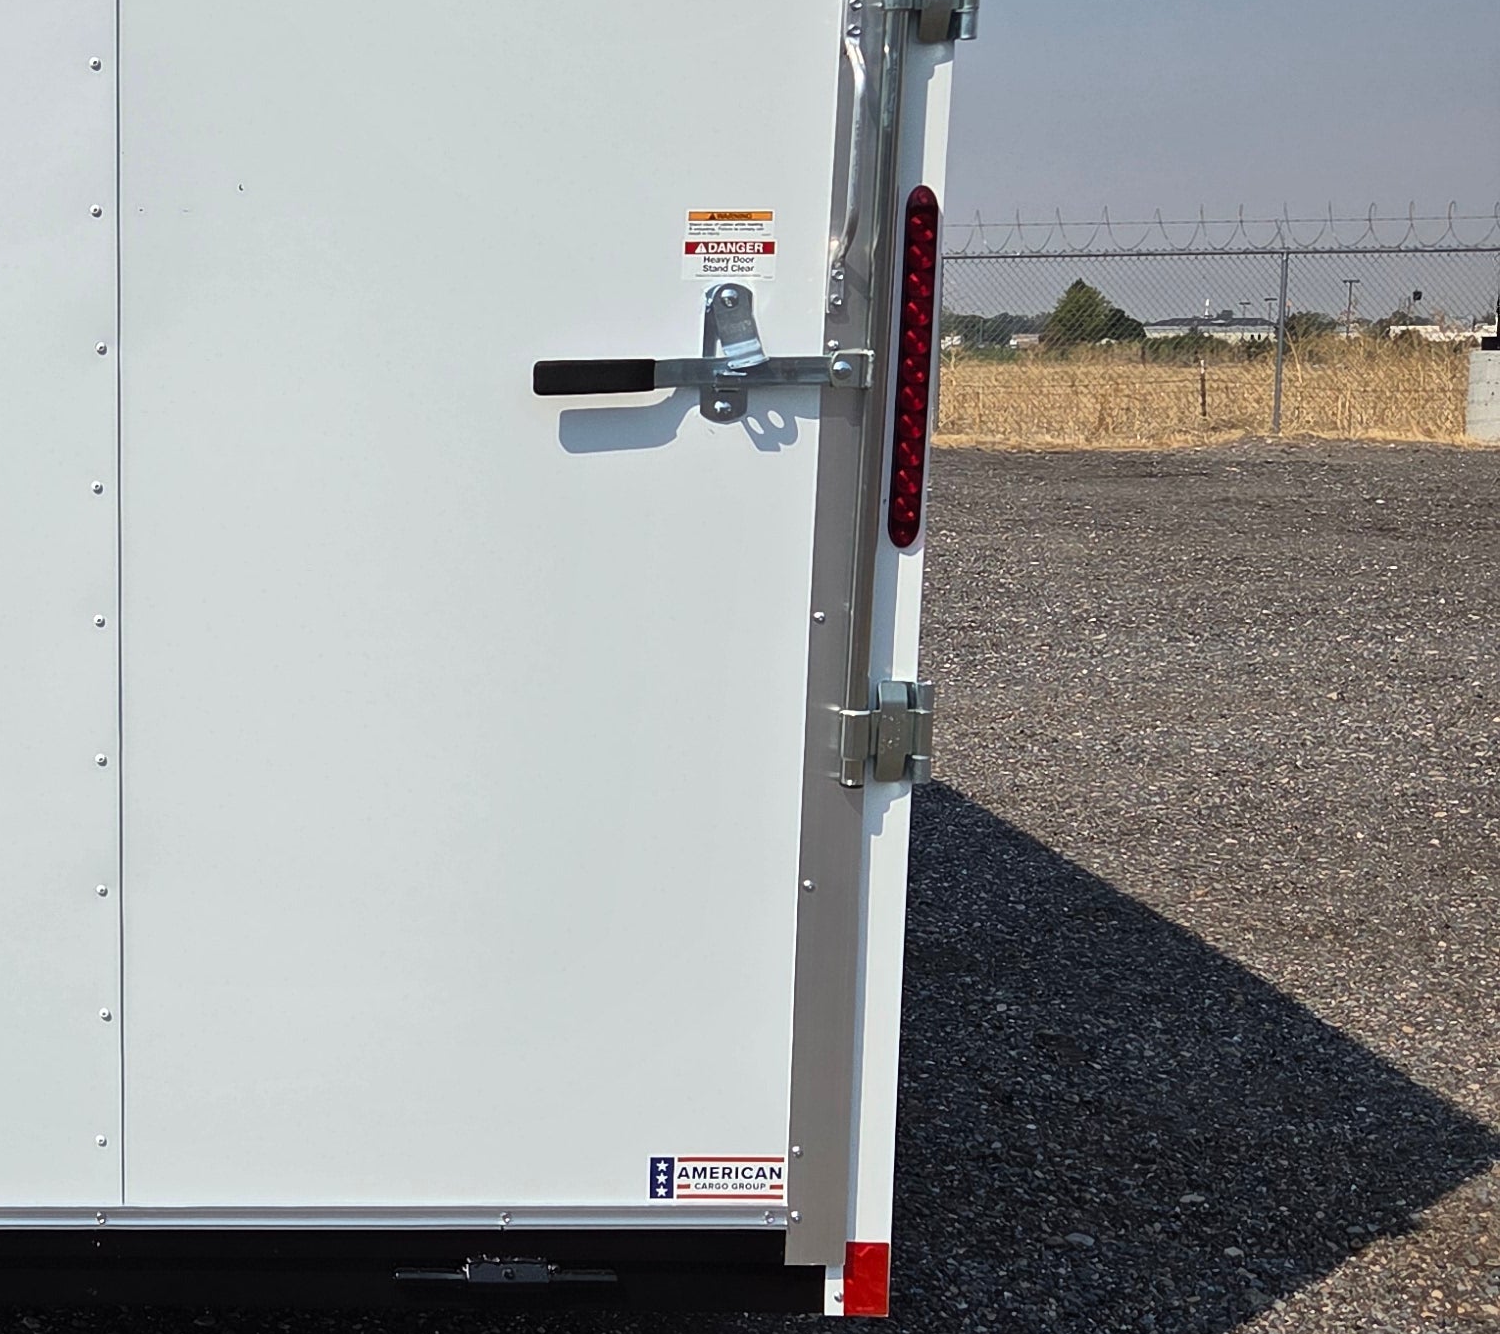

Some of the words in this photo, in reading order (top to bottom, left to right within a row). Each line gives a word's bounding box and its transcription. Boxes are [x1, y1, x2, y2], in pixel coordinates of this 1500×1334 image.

[708, 242, 764, 253] DANGER
[703, 256, 731, 265] Heavy
[731, 264, 754, 272] Clear
[677, 1166, 782, 1180] AMERICAN
[694, 1182, 729, 1190] CARGO
[731, 1182, 766, 1190] GROUP
